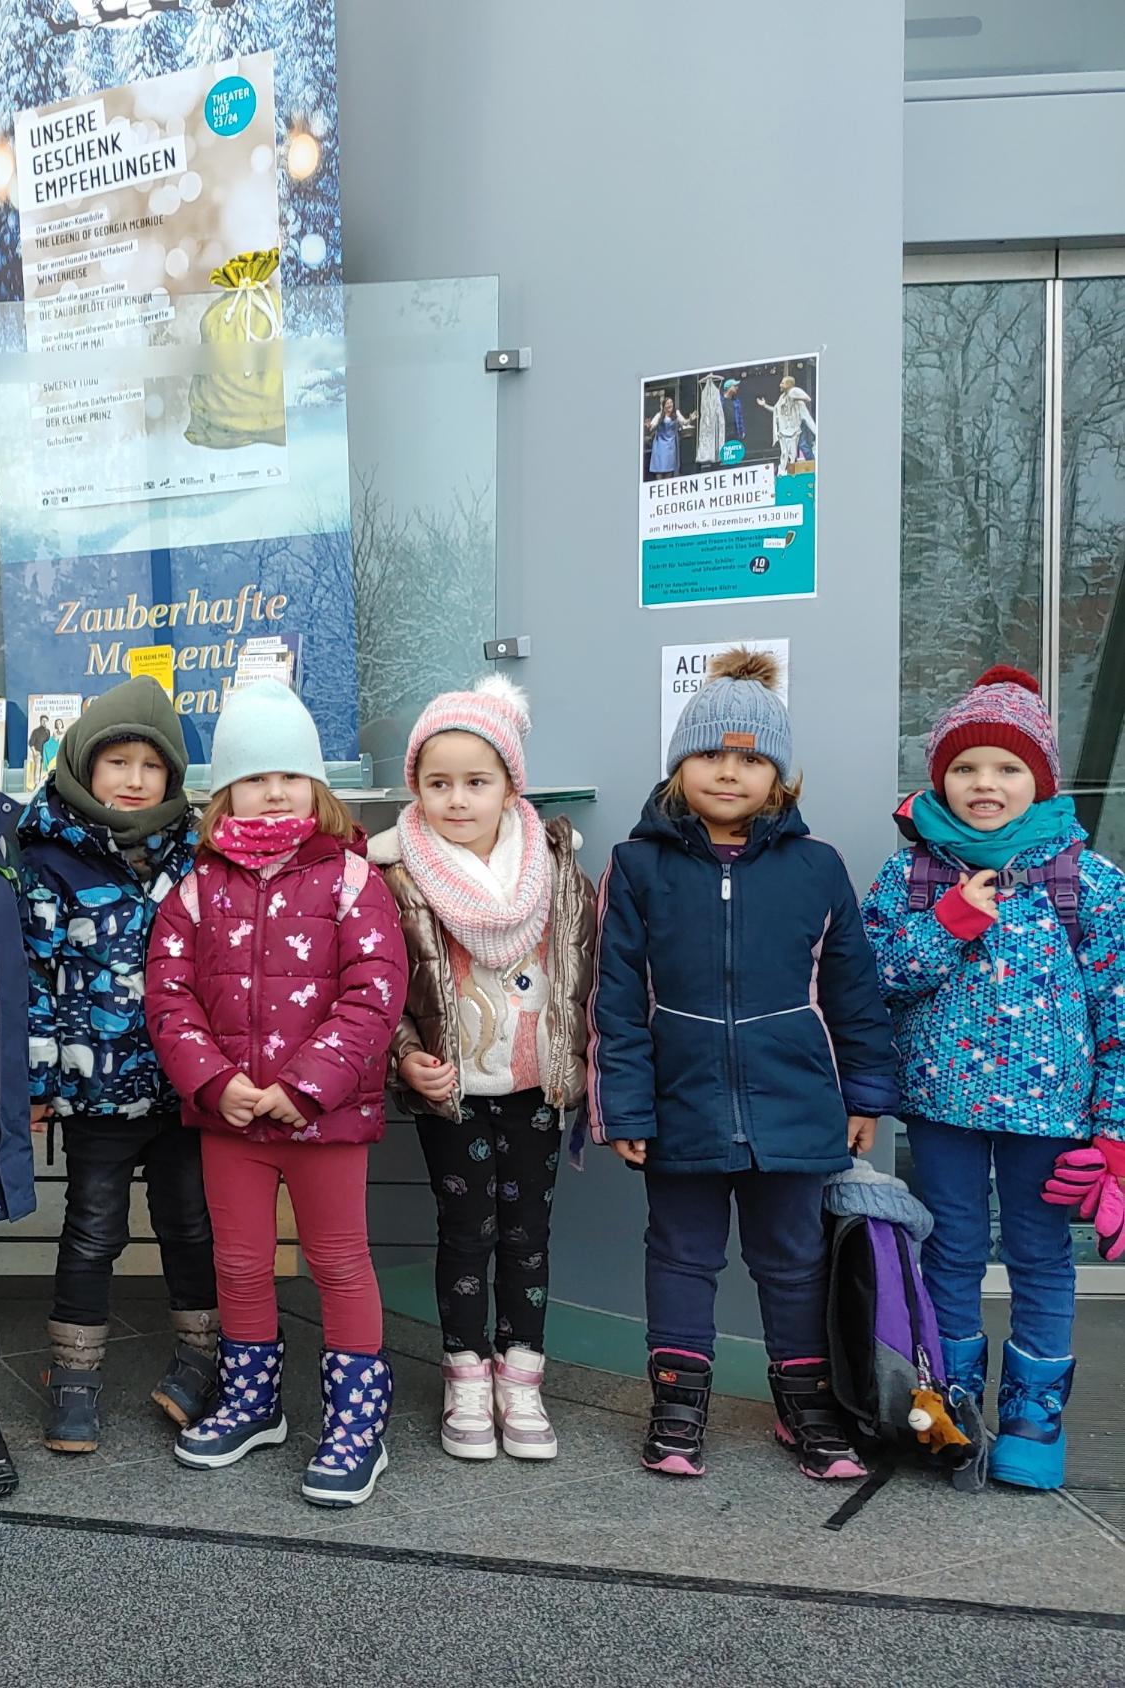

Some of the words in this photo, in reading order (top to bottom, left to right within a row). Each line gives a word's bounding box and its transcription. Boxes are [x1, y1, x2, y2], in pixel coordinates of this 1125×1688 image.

[212, 87, 250, 105] THEATER
[213, 103, 230, 117] HOF
[30, 109, 97, 149] UNSERE
[214, 113, 238, 128] 23/24
[32, 132, 123, 176] GESCHENK
[35, 147, 176, 203] EMPFEHLUNGEN
[35, 237, 50, 249] THE
[51, 231, 80, 247] LEGEND
[82, 229, 92, 240] OF
[94, 222, 128, 237] GEORGIA
[129, 214, 164, 231] MCBRIDE
[37, 267, 88, 287] WINTERREISE
[46, 416, 60, 428] DER
[62, 413, 87, 426] KLEINE
[89, 410, 112, 423] PRINZ
[649, 479, 699, 499] FEIERN
[704, 474, 727, 491] SIE
[732, 470, 758, 487] MIT
[650, 500, 705, 518] „GEORGIA
[709, 490, 768, 508] MCBRIDE“
[649, 525, 660, 533] am
[663, 517, 700, 532] Mittwoch,
[712, 515, 755, 527] Dezember,
[758, 513, 781, 524] 19.30
[783, 511, 799, 521] Uhr
[754, 558, 765, 567] 10
[55, 583, 288, 635] Zauberhafte
[84, 637, 247, 677] Ment
